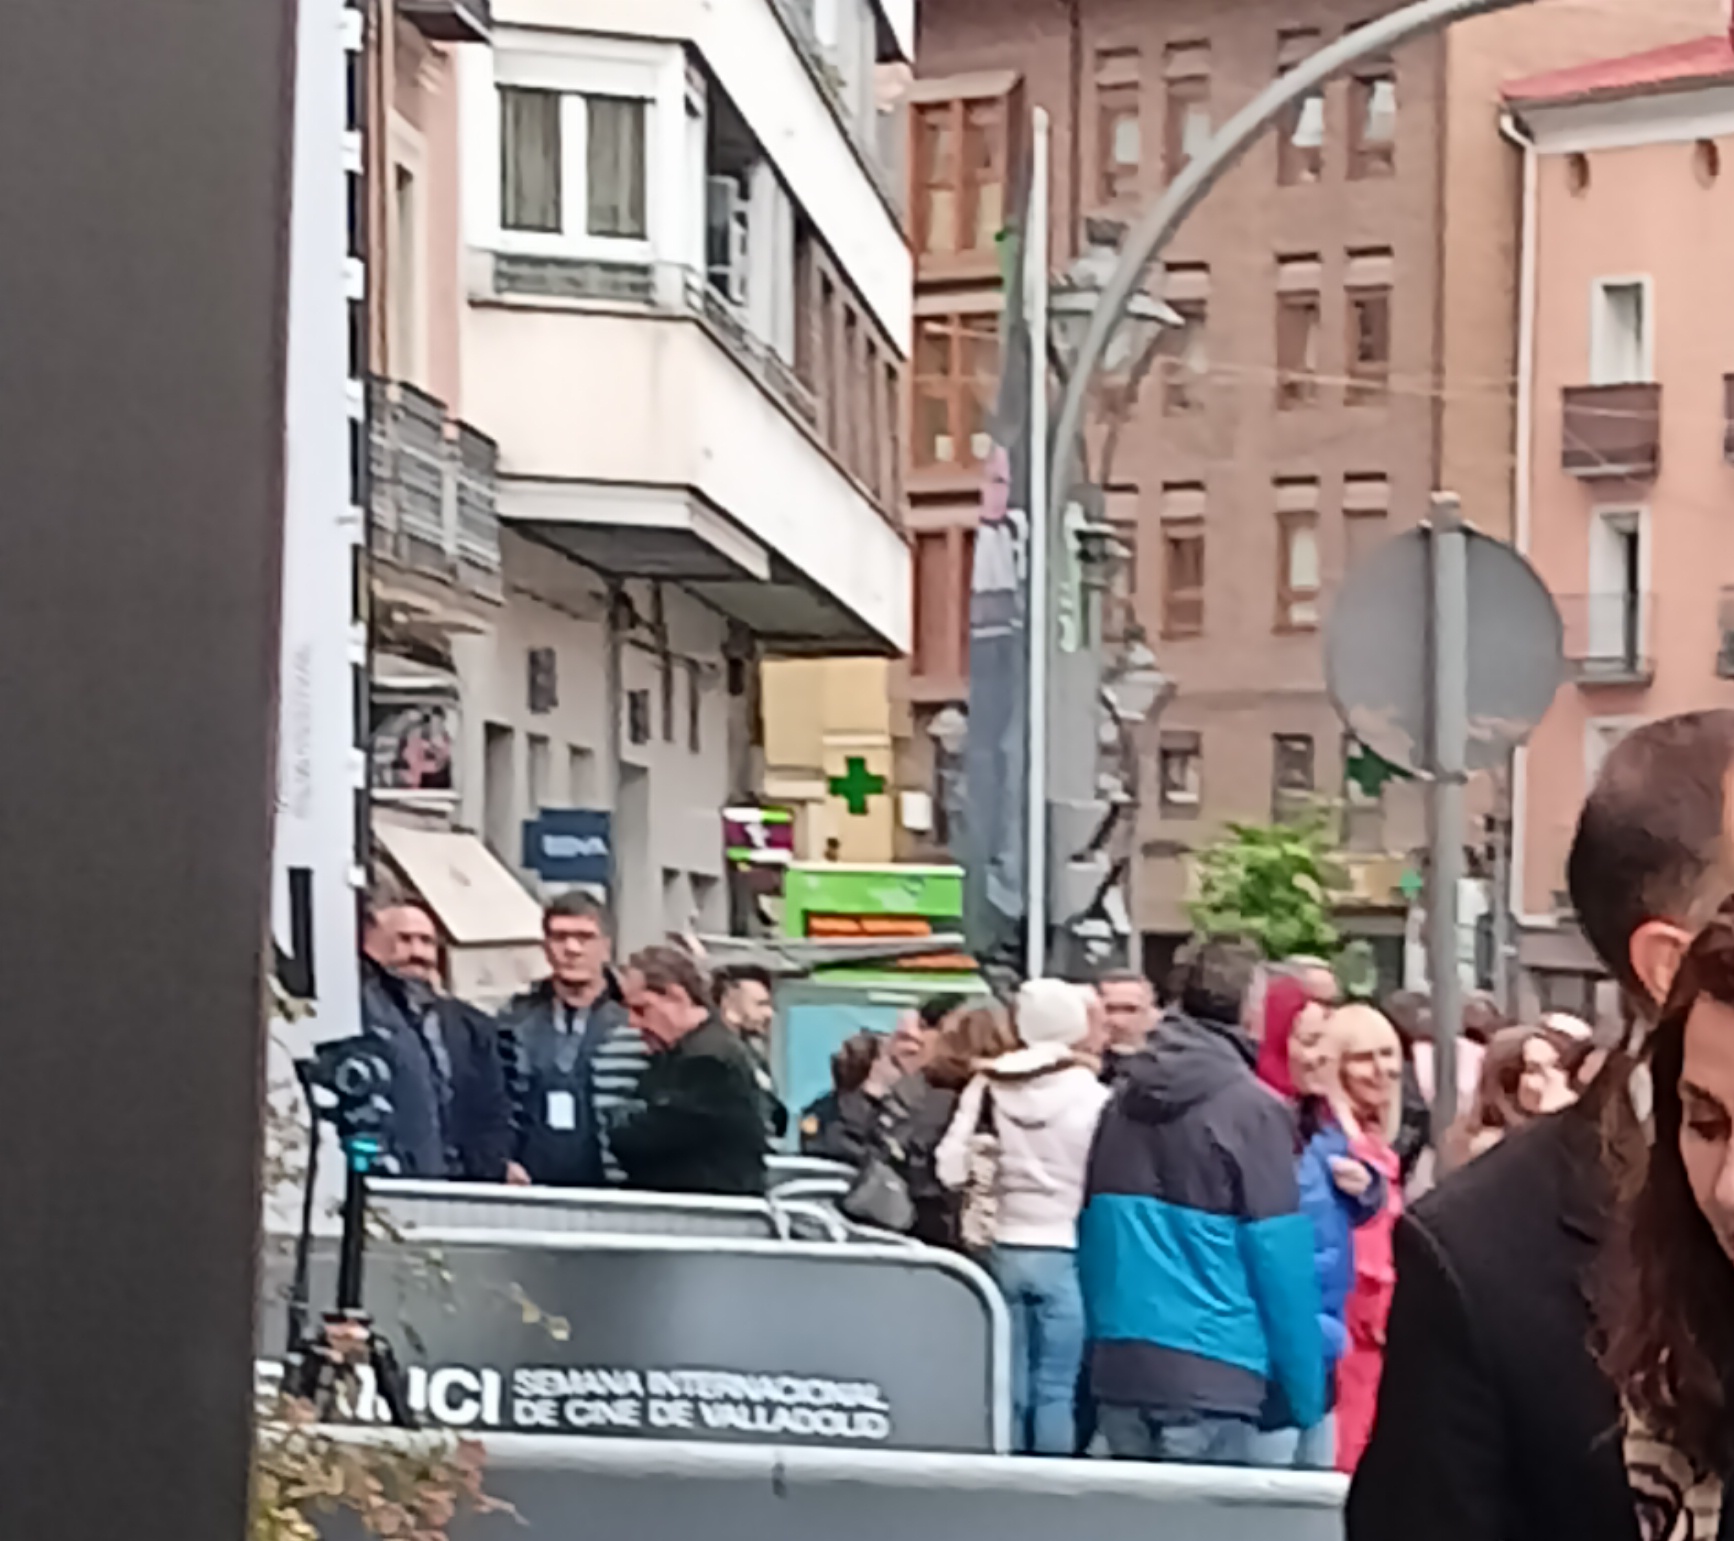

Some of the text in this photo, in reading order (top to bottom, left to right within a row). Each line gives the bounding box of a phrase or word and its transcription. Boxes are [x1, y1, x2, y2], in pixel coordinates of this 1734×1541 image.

[513, 1368, 644, 1398] SEMANA
[513, 1398, 891, 1440] DE CINE DE VALLADOLID
